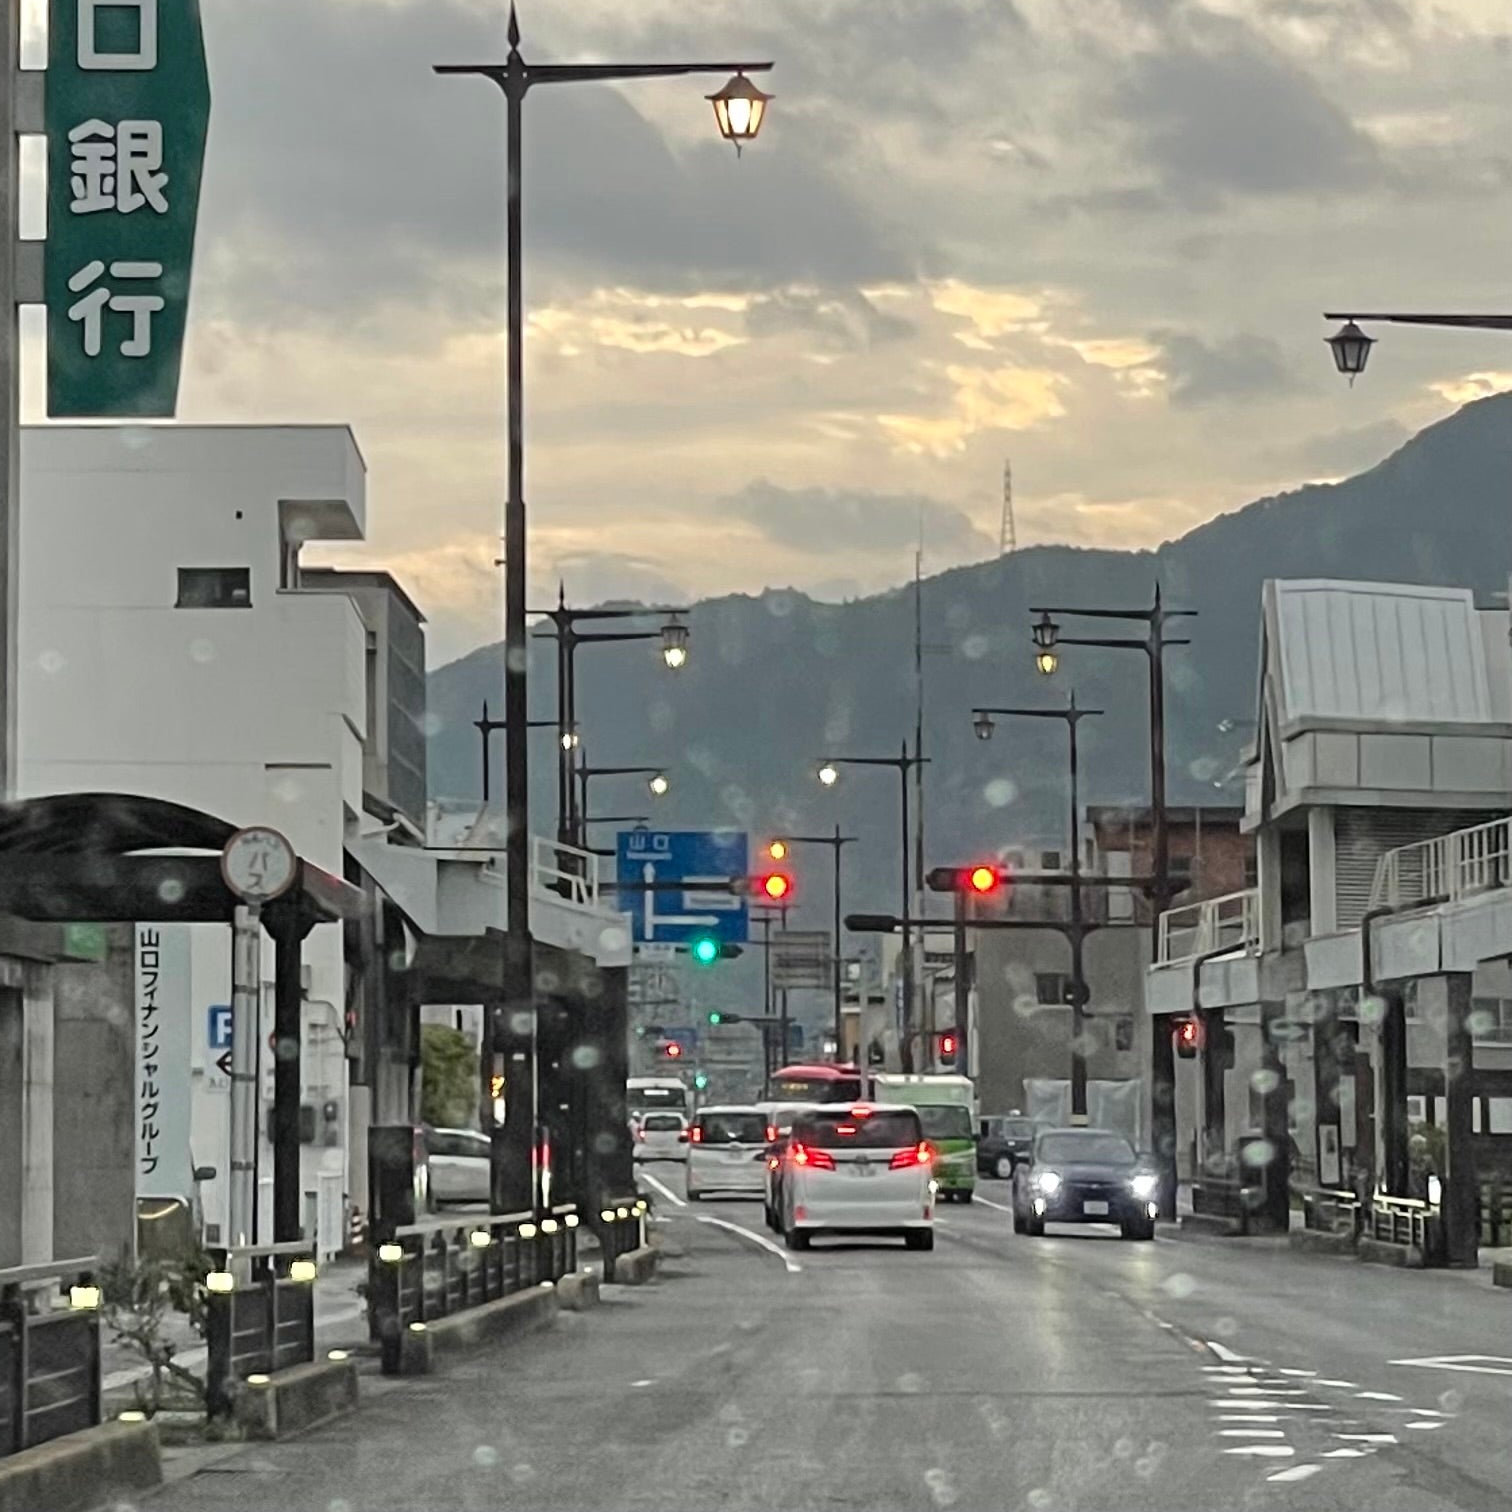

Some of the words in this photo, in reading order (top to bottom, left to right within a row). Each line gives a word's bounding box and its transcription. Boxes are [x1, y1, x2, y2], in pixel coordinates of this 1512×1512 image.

[629, 834, 669, 850] 山口
[140, 928, 159, 1175] 山口フィナンシャルグループ
